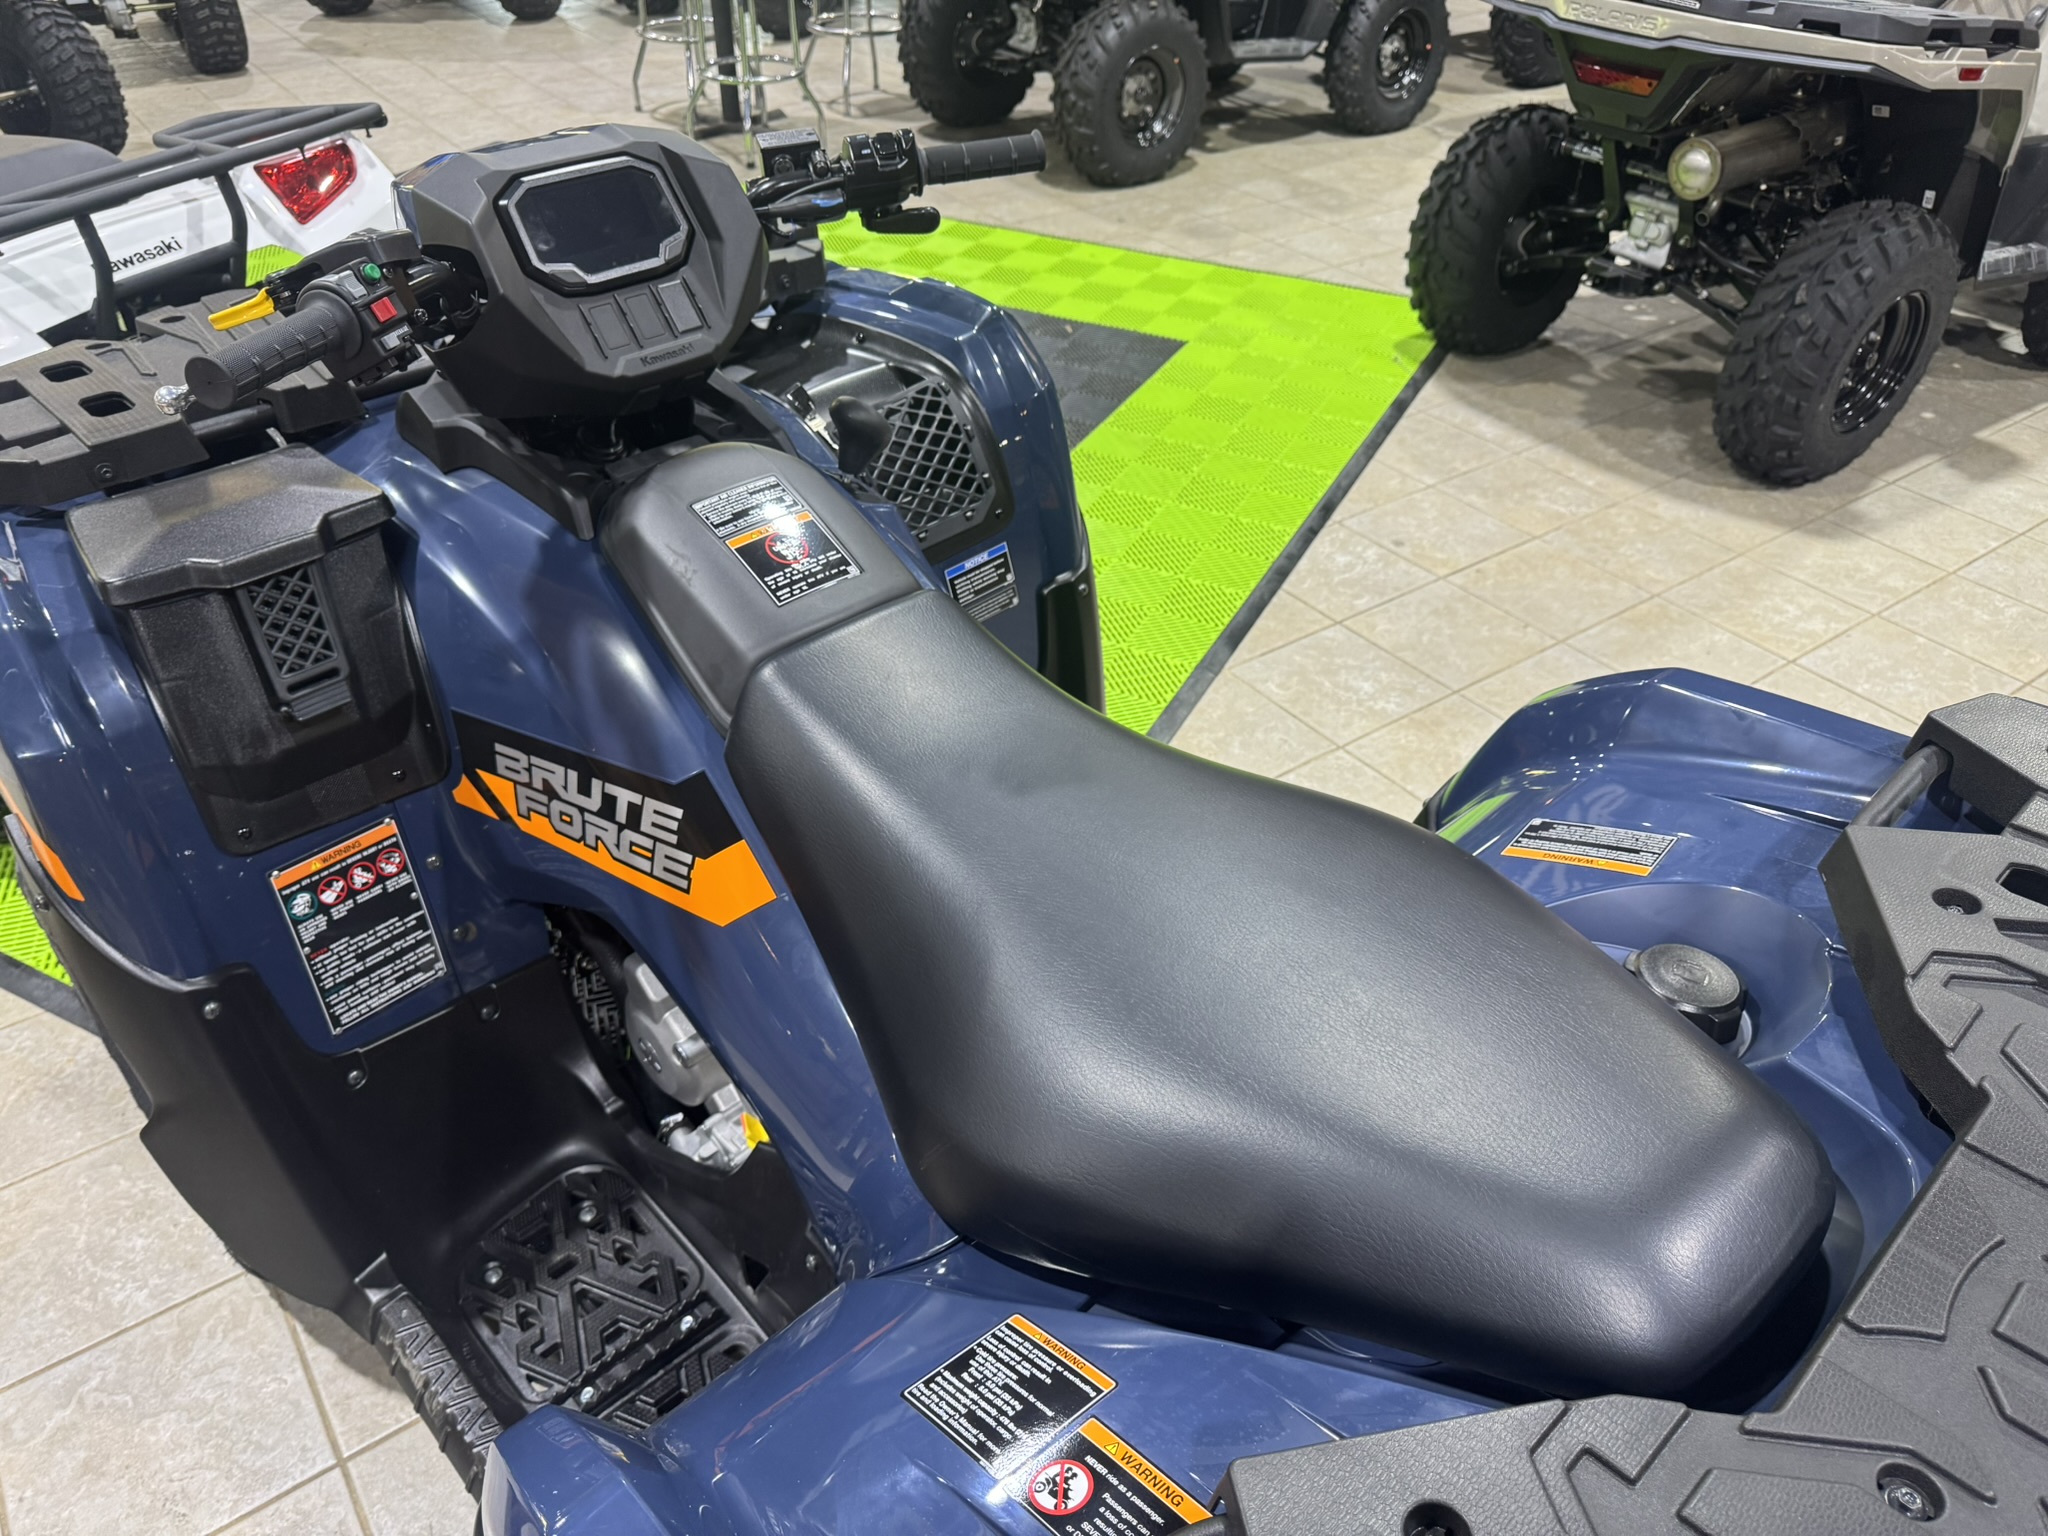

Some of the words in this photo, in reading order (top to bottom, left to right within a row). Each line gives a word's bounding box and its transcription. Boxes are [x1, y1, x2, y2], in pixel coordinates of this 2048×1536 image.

[1567, 2, 1660, 36] POLARIS
[110, 236, 182, 272] awasaki
[641, 343, 696, 367] Kawasaki
[964, 552, 988, 569] NOTICE
[494, 742, 684, 845] BRUTE
[320, 839, 362, 864] WARNING
[516, 784, 693, 890] FORCE
[1541, 852, 1594, 865] WARNING
[1042, 1336, 1086, 1370] WARNING
[1084, 1454, 1108, 1476] NEVER
[1105, 1473, 1119, 1486] ride
[1117, 1483, 1127, 1493] as
[1129, 1494, 1165, 1526] passenger.
[1119, 1450, 1184, 1507] WARNING
[1101, 1491, 1138, 1526] Passengers
[1136, 1523, 1150, 1536] can
[1103, 1509, 1119, 1524] loss
[1116, 1522, 1128, 1530] of
